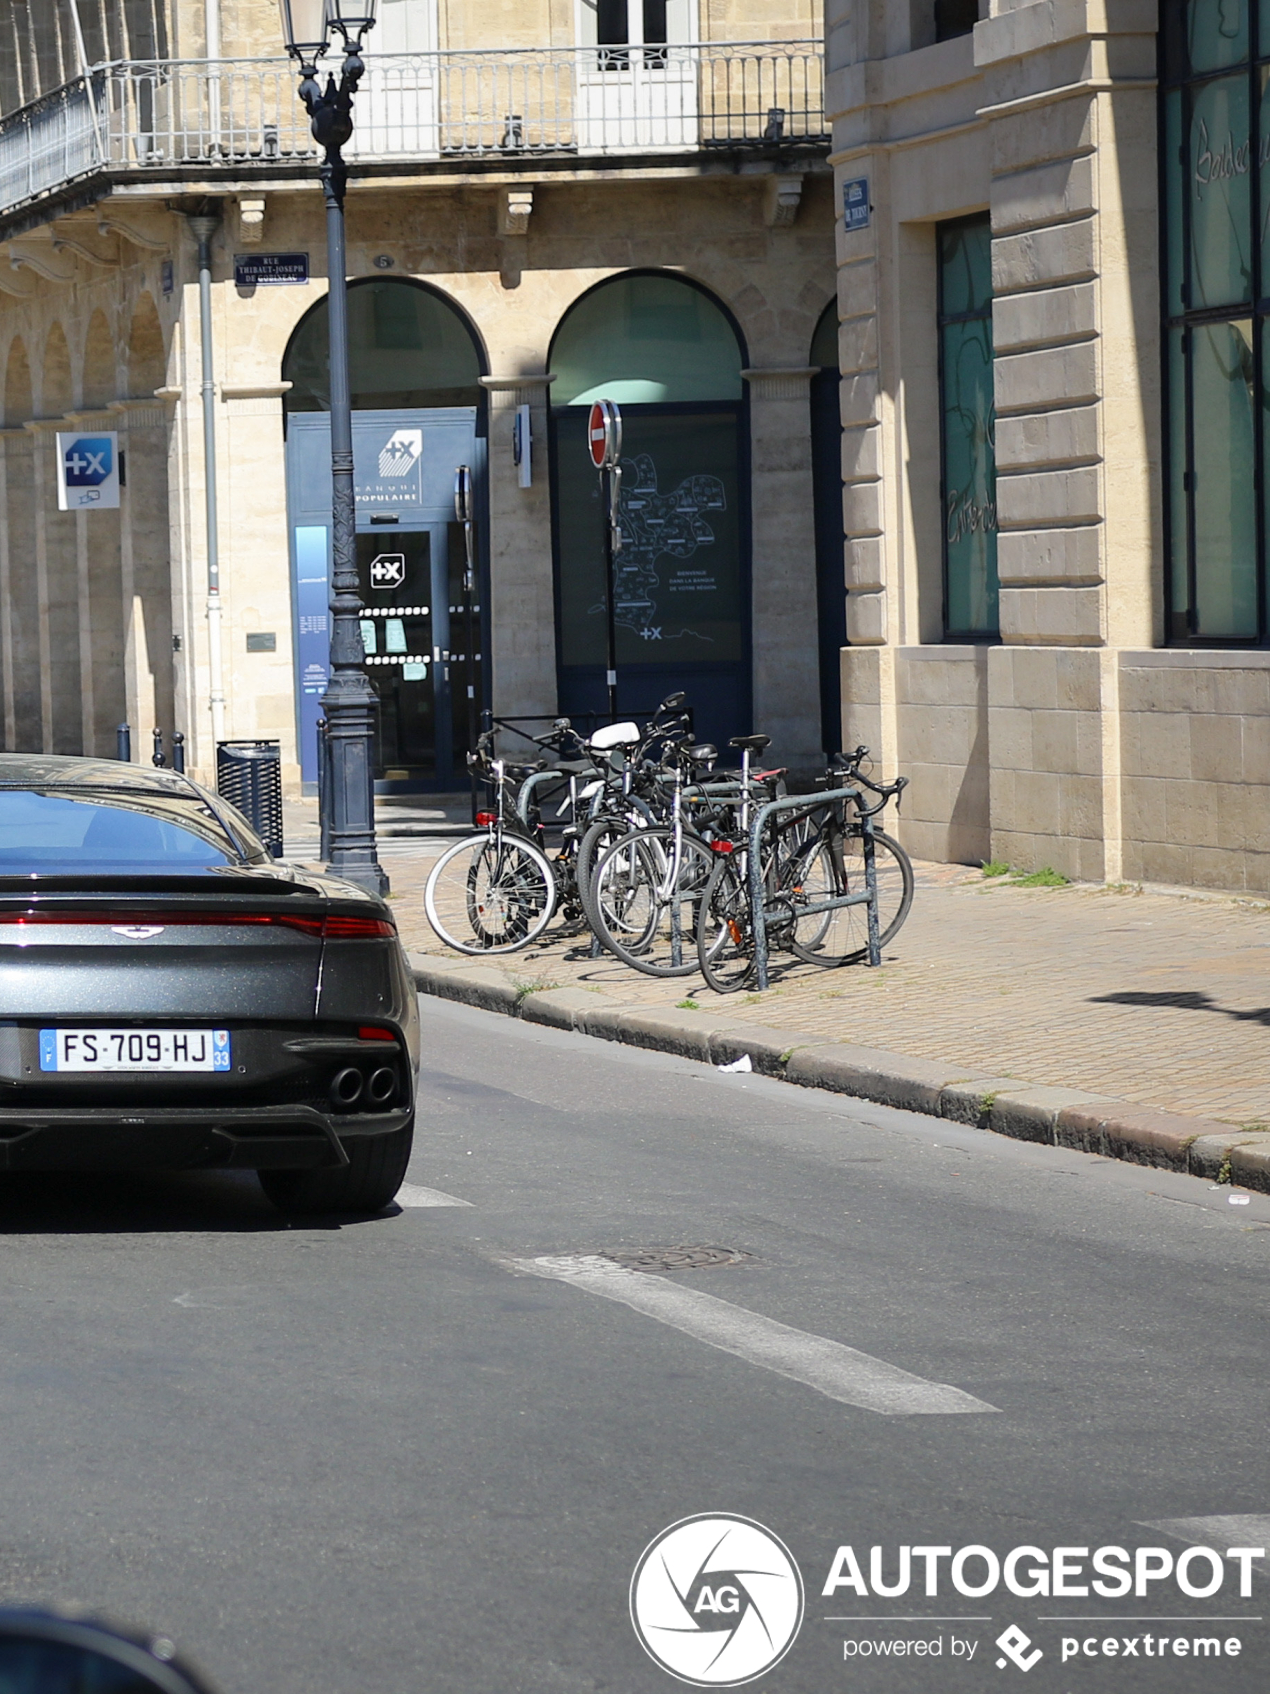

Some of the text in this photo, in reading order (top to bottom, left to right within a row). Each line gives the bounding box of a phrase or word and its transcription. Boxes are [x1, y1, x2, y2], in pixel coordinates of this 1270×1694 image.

[263, 257, 279, 265] RUE
[379, 256, 388, 268] 5
[238, 265, 304, 274] THIBAUT-JOSEPH
[257, 273, 298, 282] GOBINEAU
[355, 493, 417, 502] POPULAIRE
[46, 1034, 229, 1066] F FS-709-HJ 33
